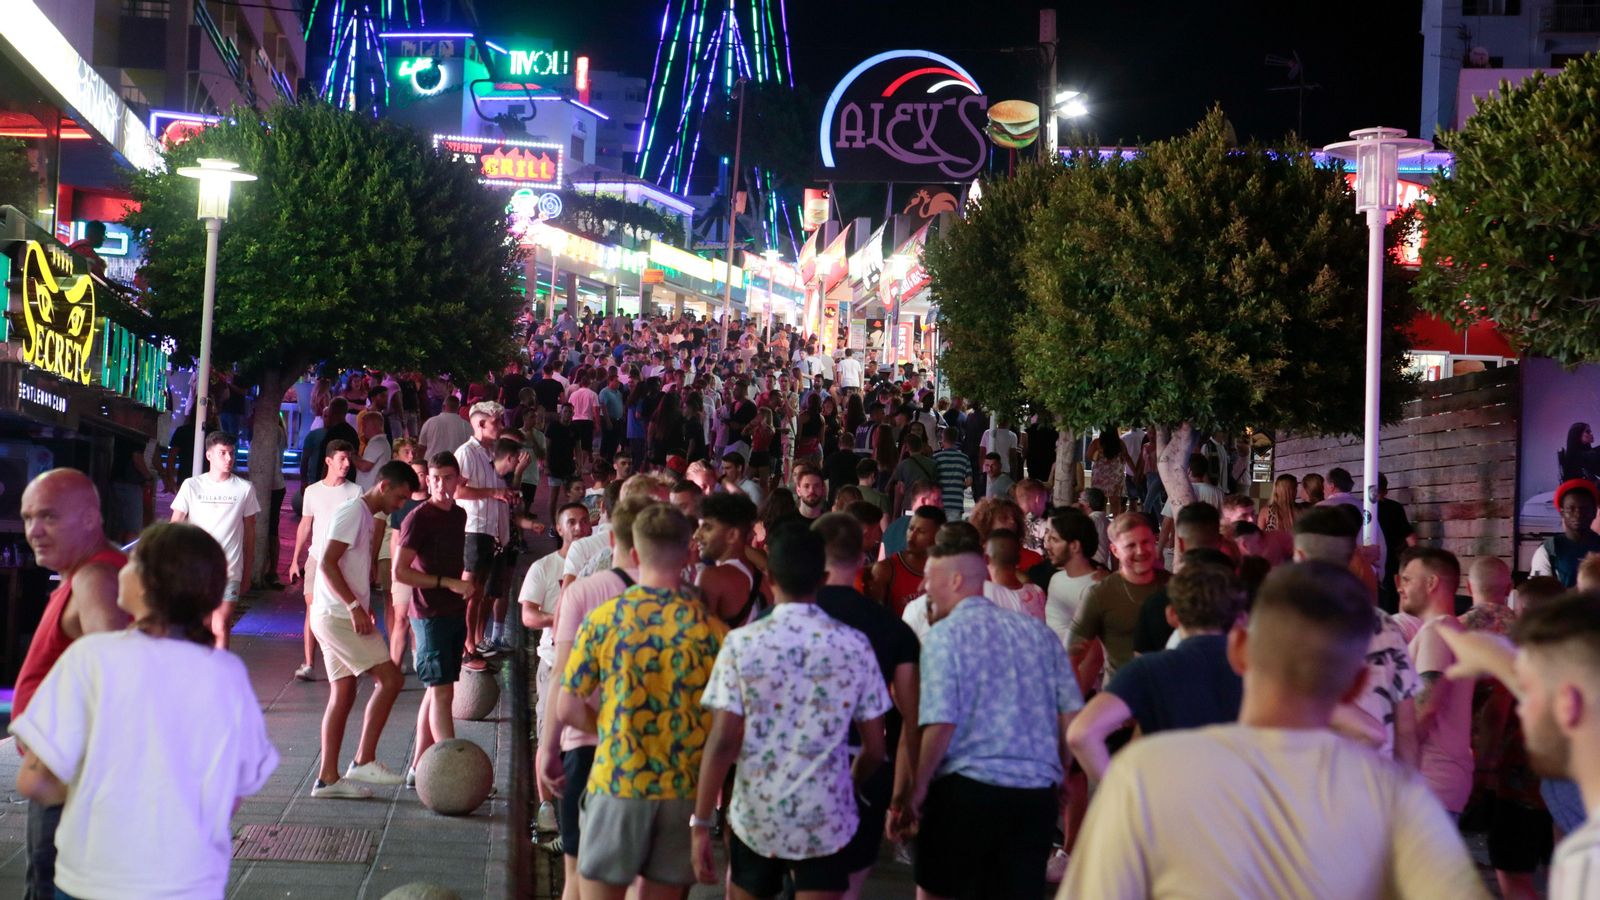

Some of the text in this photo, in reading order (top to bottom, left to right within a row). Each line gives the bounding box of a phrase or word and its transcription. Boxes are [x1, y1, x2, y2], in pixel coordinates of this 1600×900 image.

[509, 50, 568, 75] TIVOLI
[835, 95, 988, 178] ALEX'S
[484, 158, 552, 179] GRILL
[898, 327, 907, 357] BEST
